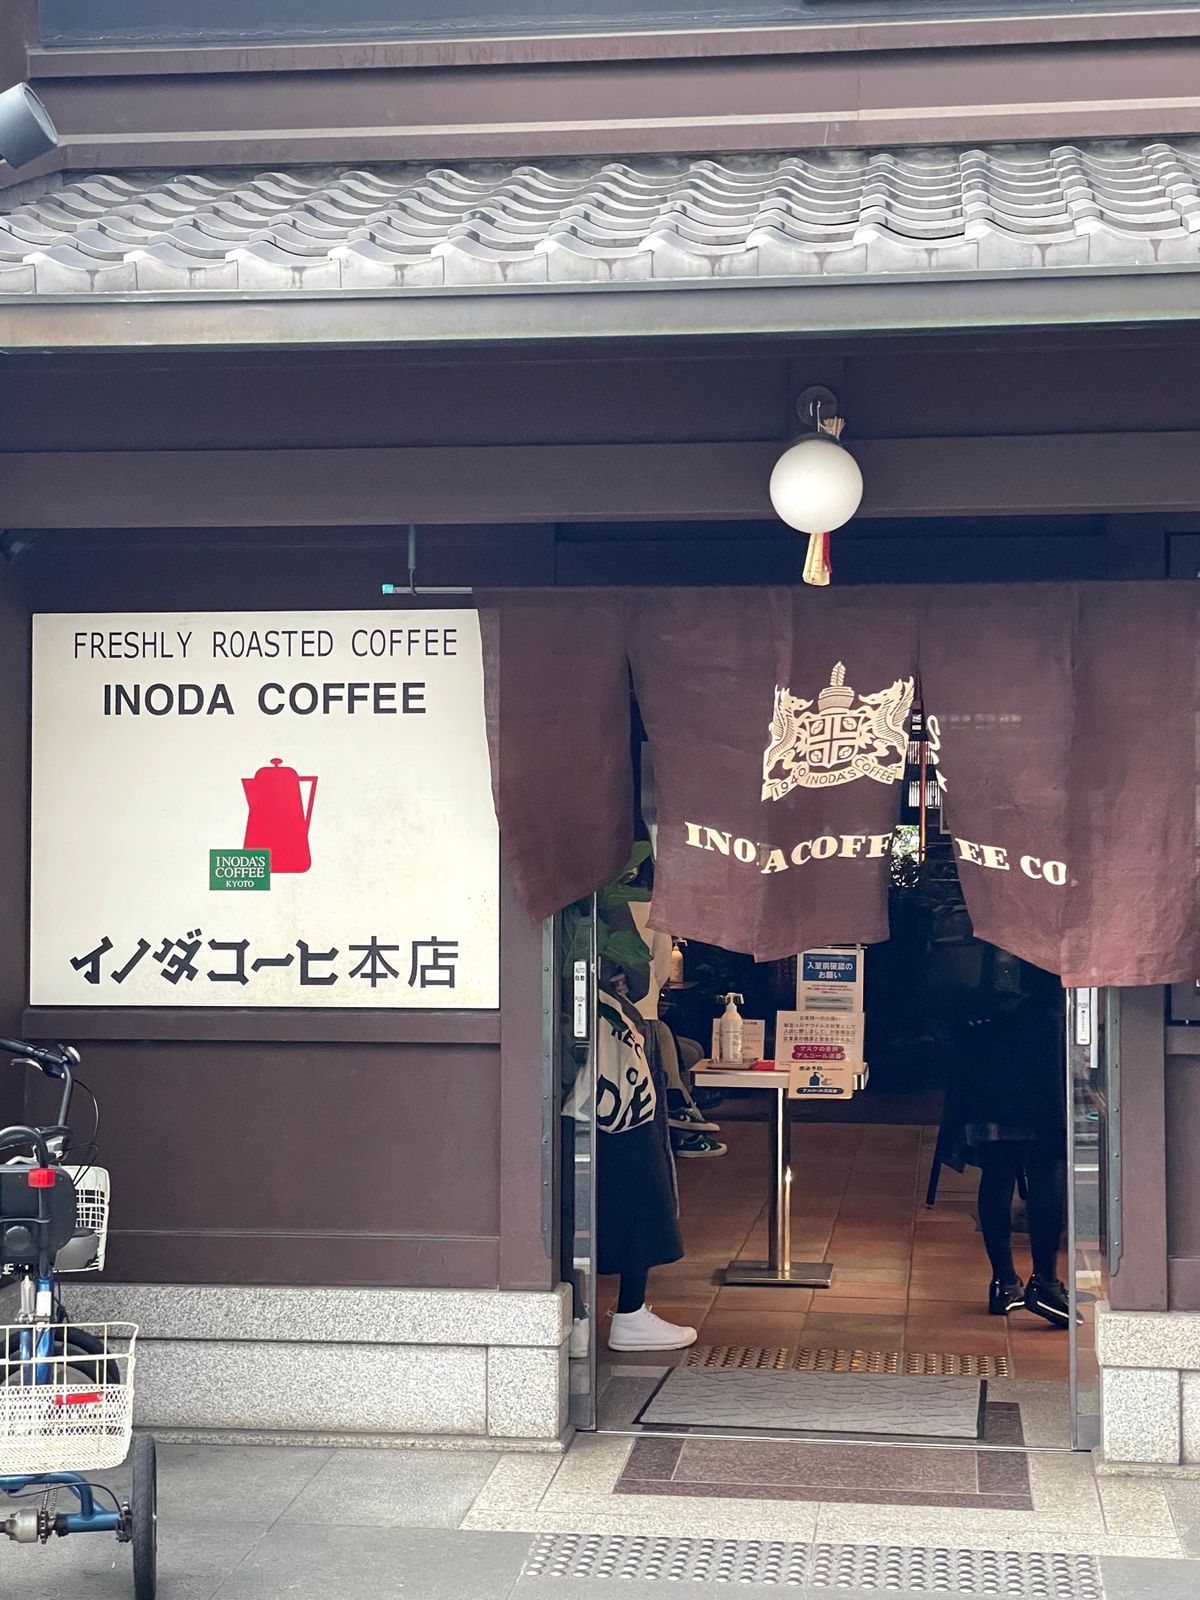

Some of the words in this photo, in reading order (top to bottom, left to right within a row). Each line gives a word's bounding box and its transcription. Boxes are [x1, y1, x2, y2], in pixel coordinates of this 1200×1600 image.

[74, 631, 192, 659] FRESHLY
[213, 630, 334, 658] ROASTED
[351, 628, 457, 657] COFFEE
[104, 683, 235, 716] INODA
[257, 682, 427, 716] COFFEE
[805, 768, 857, 785] INODA'S
[854, 758, 896, 782] COFFEE
[215, 855, 266, 867] INODA'S
[215, 867, 265, 878] COFFEE
[225, 880, 255, 888] KYOTO
[69, 928, 459, 989] イノダコーヒ本店
